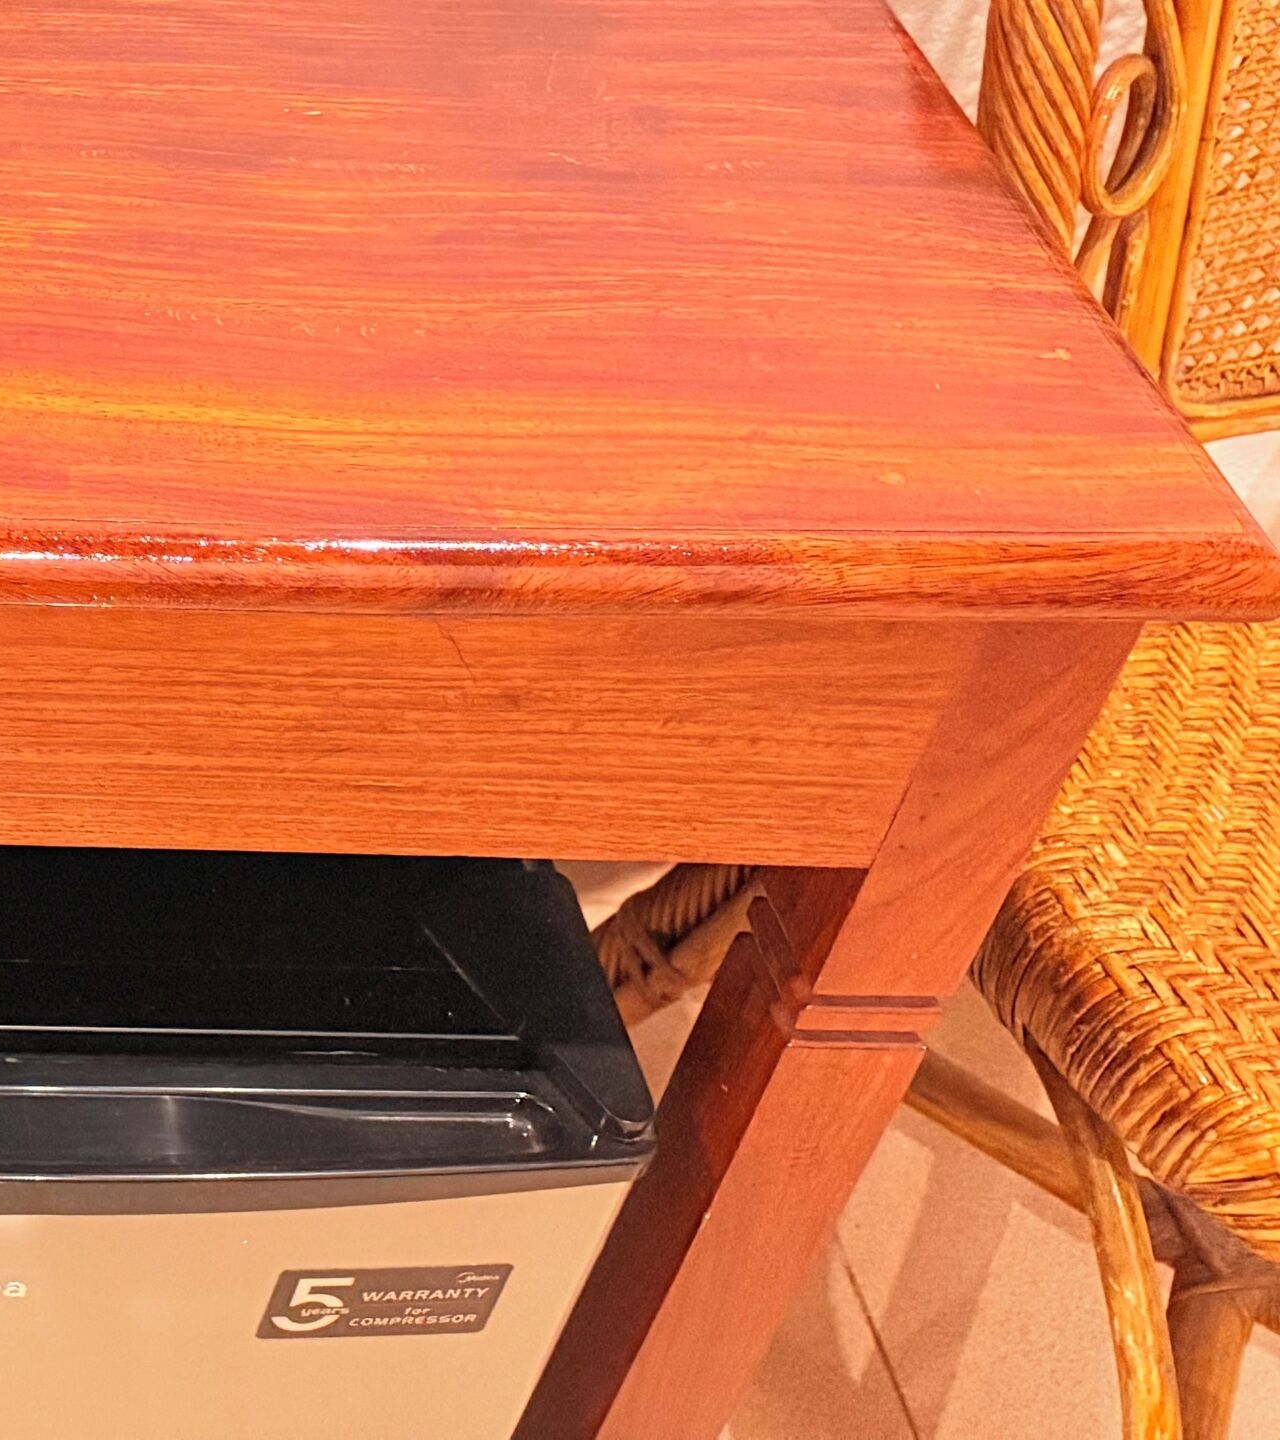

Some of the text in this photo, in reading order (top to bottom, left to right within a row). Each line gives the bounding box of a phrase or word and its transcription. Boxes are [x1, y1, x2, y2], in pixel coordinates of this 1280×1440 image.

[362, 1287, 490, 1302] WARRANTY
[271, 1277, 356, 1332] 5
[404, 1306, 430, 1315] for
[301, 1307, 350, 1317] years
[349, 1313, 477, 1327] COMPRESSOR
